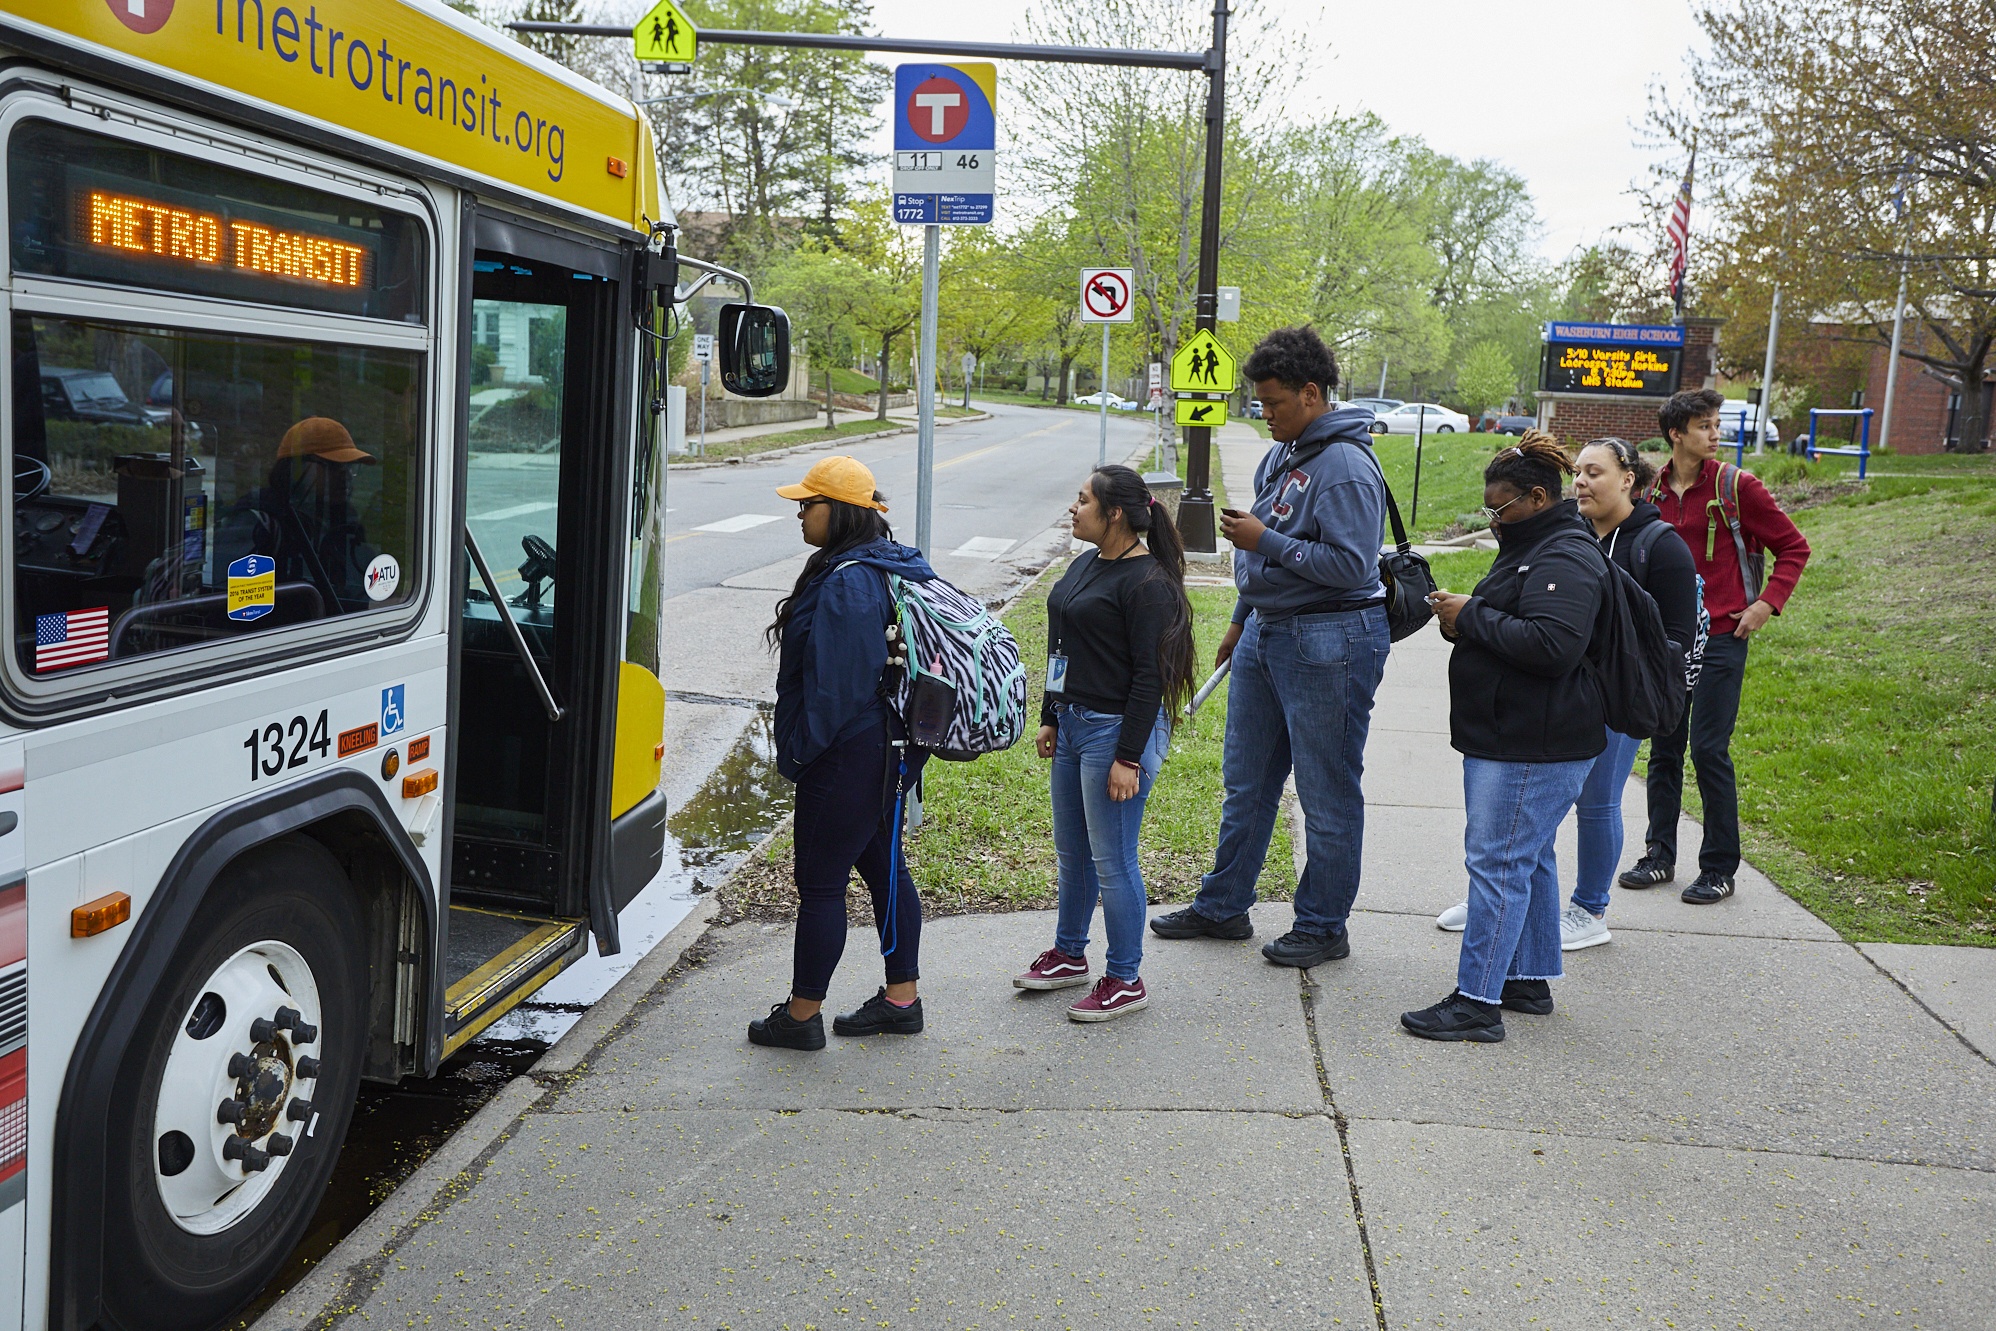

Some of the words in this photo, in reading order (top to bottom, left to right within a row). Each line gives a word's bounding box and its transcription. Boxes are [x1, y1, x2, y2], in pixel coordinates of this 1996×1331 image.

[217, 0, 565, 183] metrotransit.org
[911, 152, 927, 167] 11
[957, 154, 979, 169] 46
[907, 197, 925, 206] Stop
[940, 195, 966, 203] NexTrip
[897, 208, 924, 220] 1772
[91, 193, 218, 263] METRO
[231, 222, 362, 287] TRANSIT
[1554, 325, 1612, 339] WASHBURN
[1612, 328, 1639, 340] HIGH
[1640, 329, 1681, 342] SCHOOL
[1560, 356, 1607, 369] Lacrosse
[1611, 361, 1627, 370] vs.
[1592, 348, 1631, 362] Varsity
[1634, 350, 1658, 363] Girls
[1581, 374, 1602, 387] WHS
[1605, 376, 1644, 389] Stadium
[379, 565, 396, 581] ATU
[240, 587, 257, 595] TRANSIT
[257, 585, 273, 593] SYSTEM
[243, 709, 331, 782] 1324
[341, 727, 376, 752] KNEELING
[410, 741, 428, 759] RAMP
